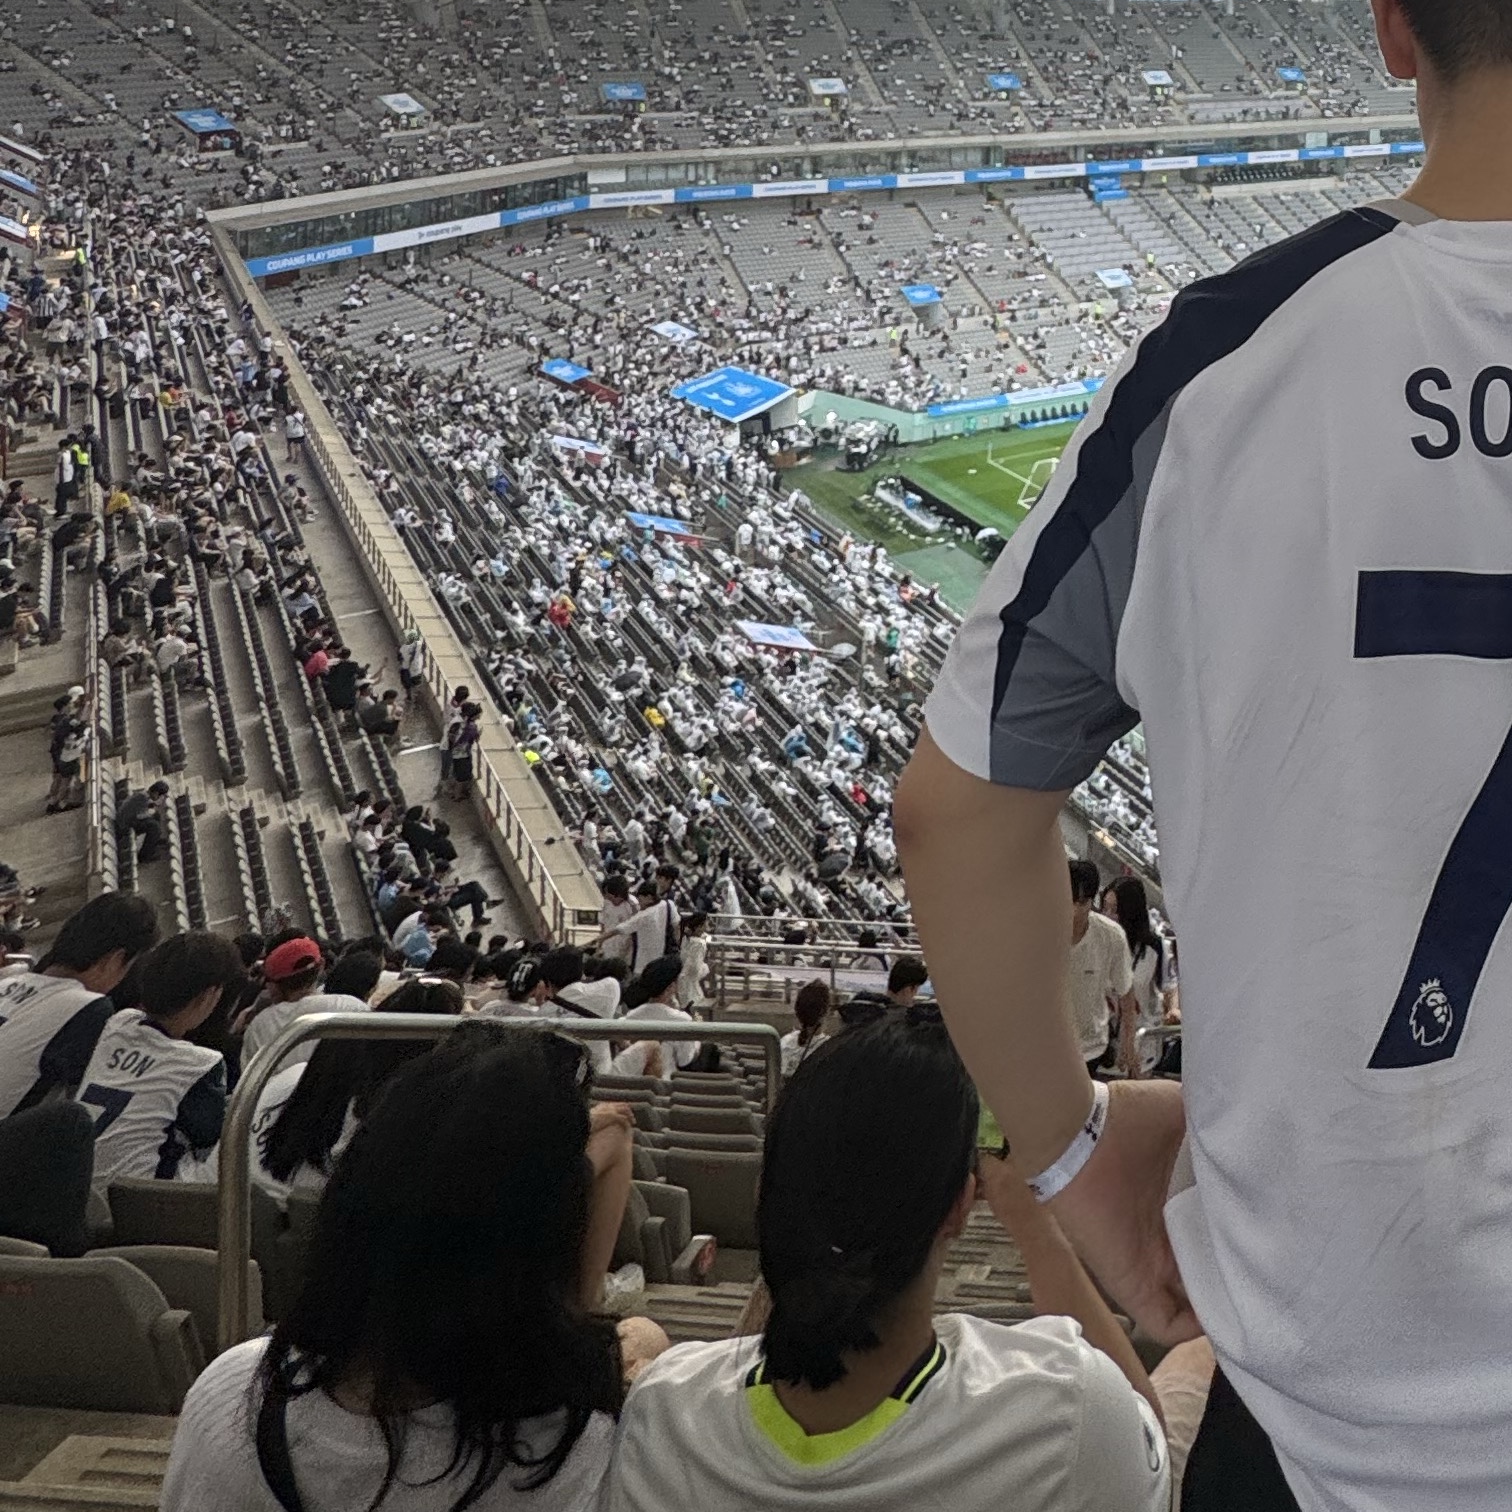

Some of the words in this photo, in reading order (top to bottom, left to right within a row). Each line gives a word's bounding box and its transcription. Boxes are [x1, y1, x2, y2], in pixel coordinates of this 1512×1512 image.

[266, 254, 306, 271] COUPANG
[306, 251, 326, 263] PLAY
[107, 1048, 156, 1078] SON
